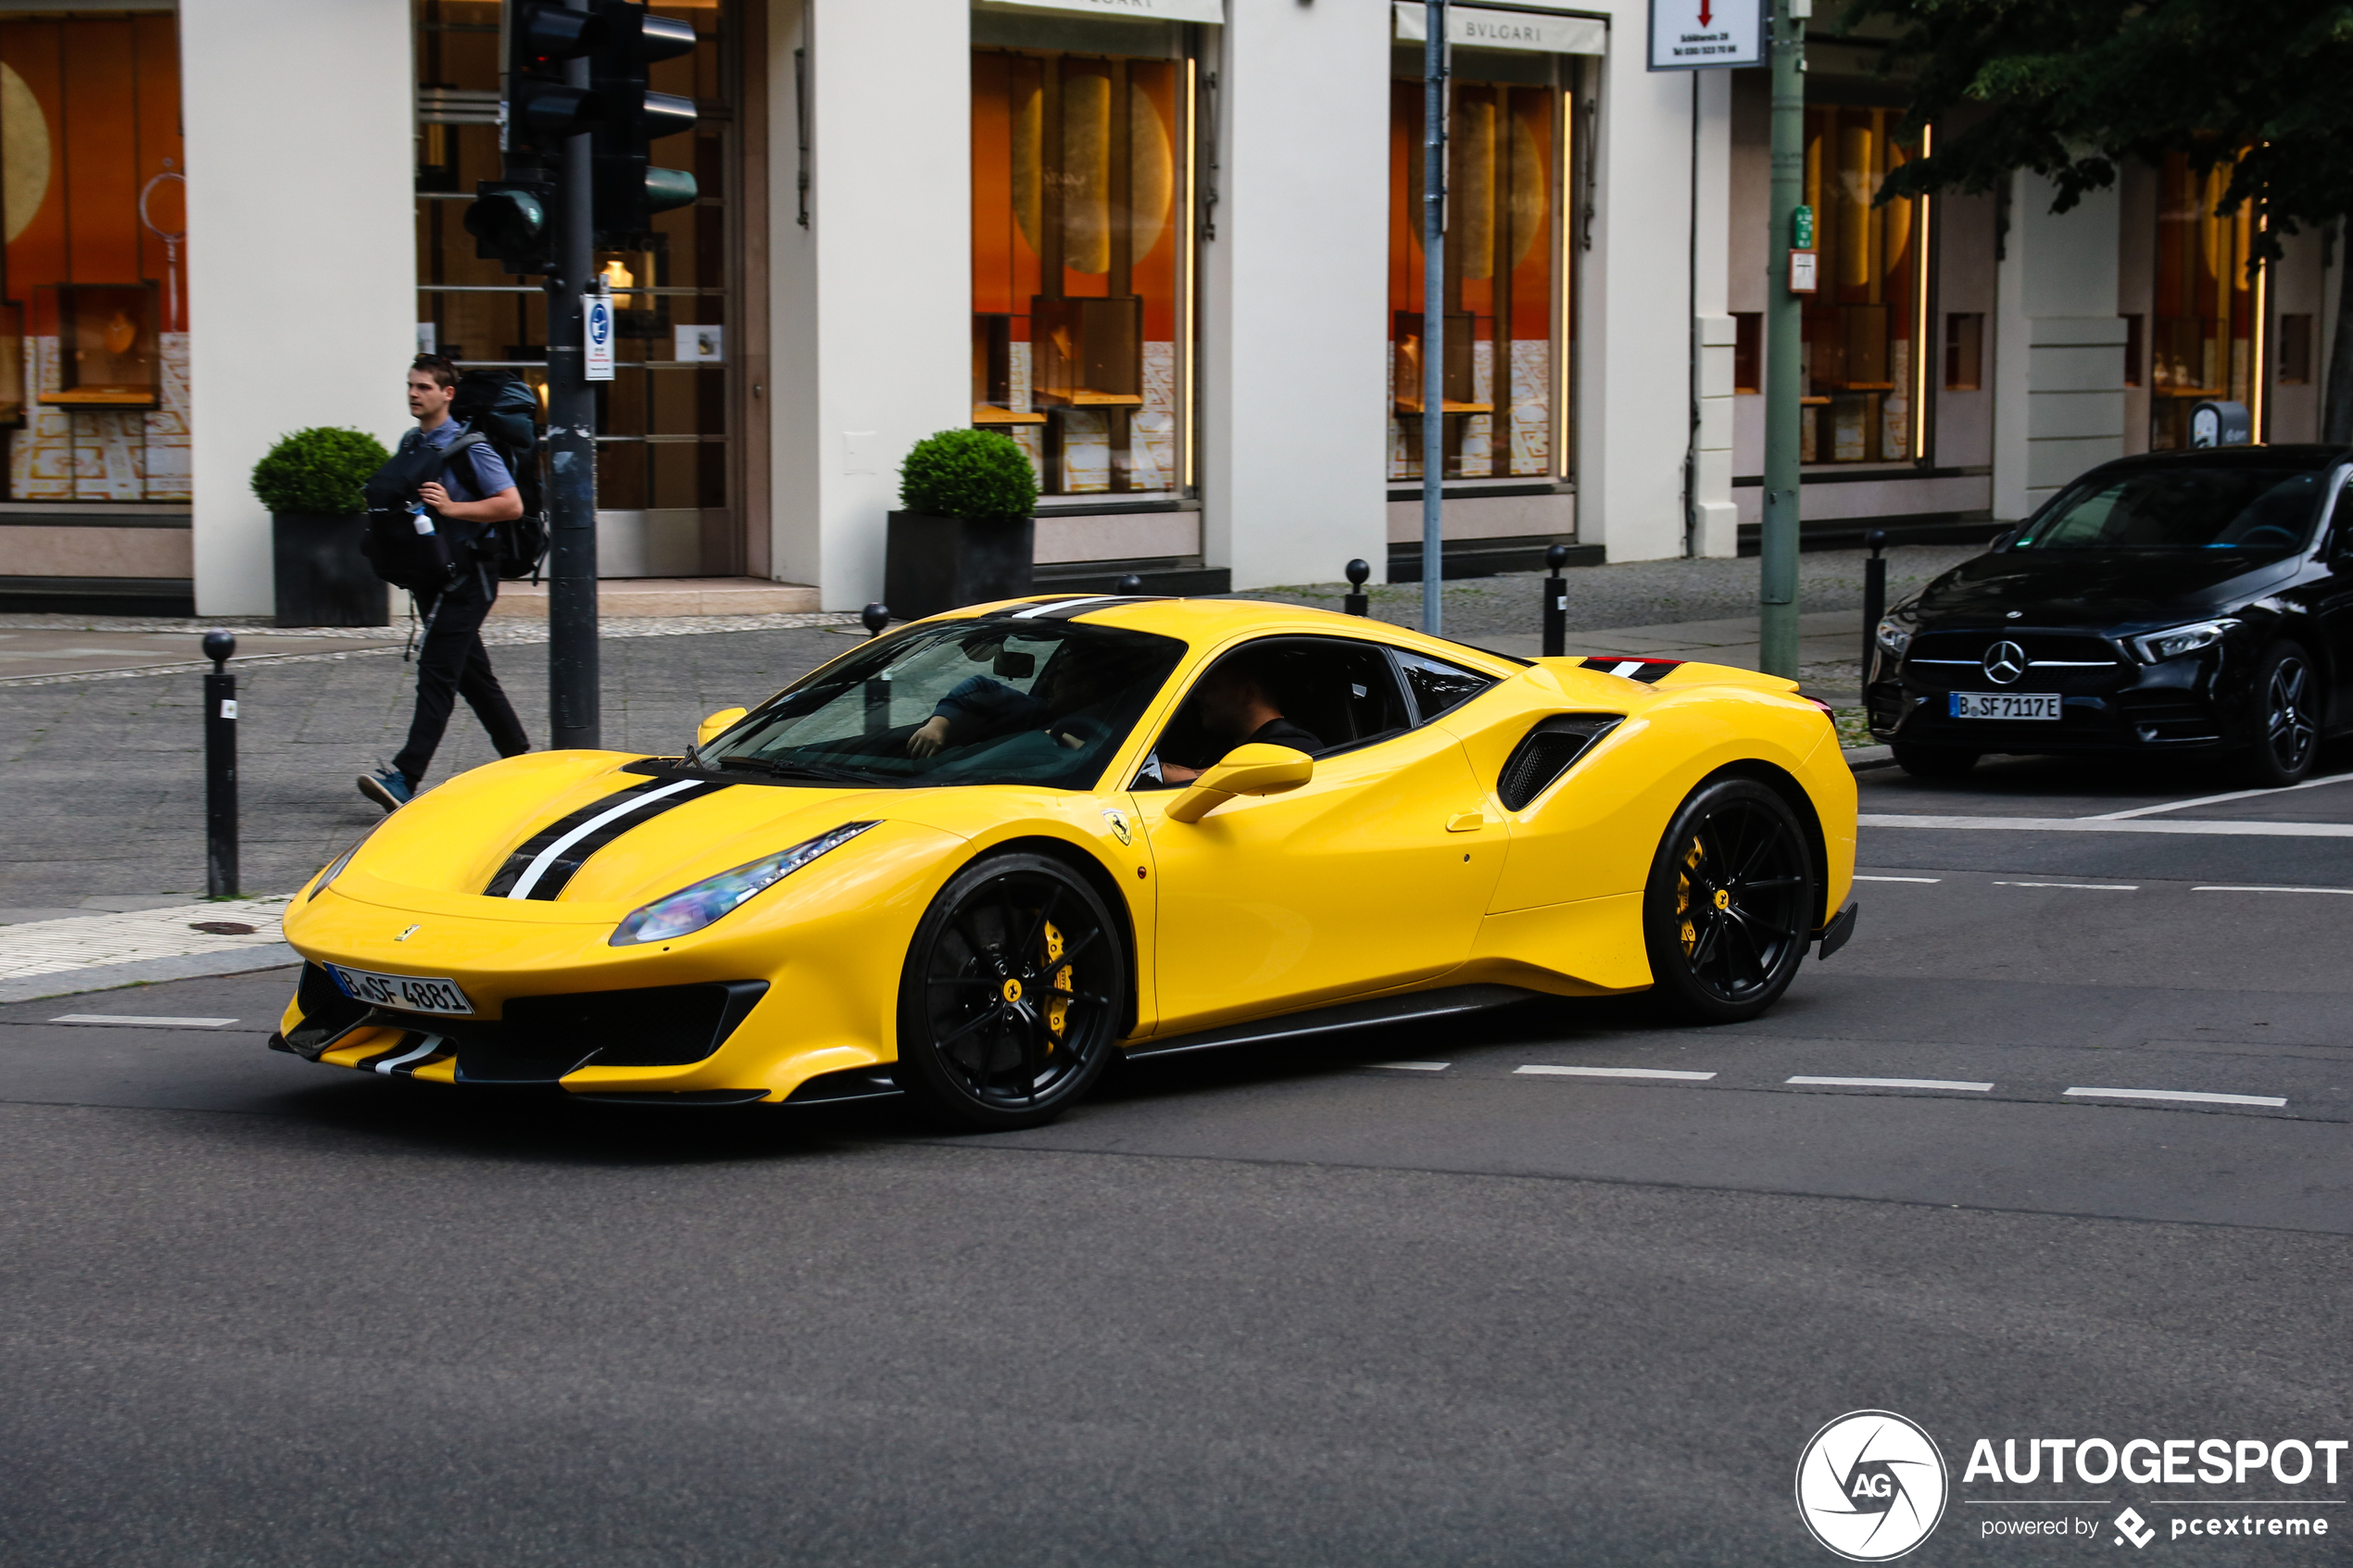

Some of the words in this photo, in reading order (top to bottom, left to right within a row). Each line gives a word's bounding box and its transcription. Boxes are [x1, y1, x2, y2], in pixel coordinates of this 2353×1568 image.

[1466, 21, 1541, 42] BVLGARI
[338, 970, 361, 997] B
[366, 976, 396, 1004] SF
[401, 981, 467, 1010] 4881
